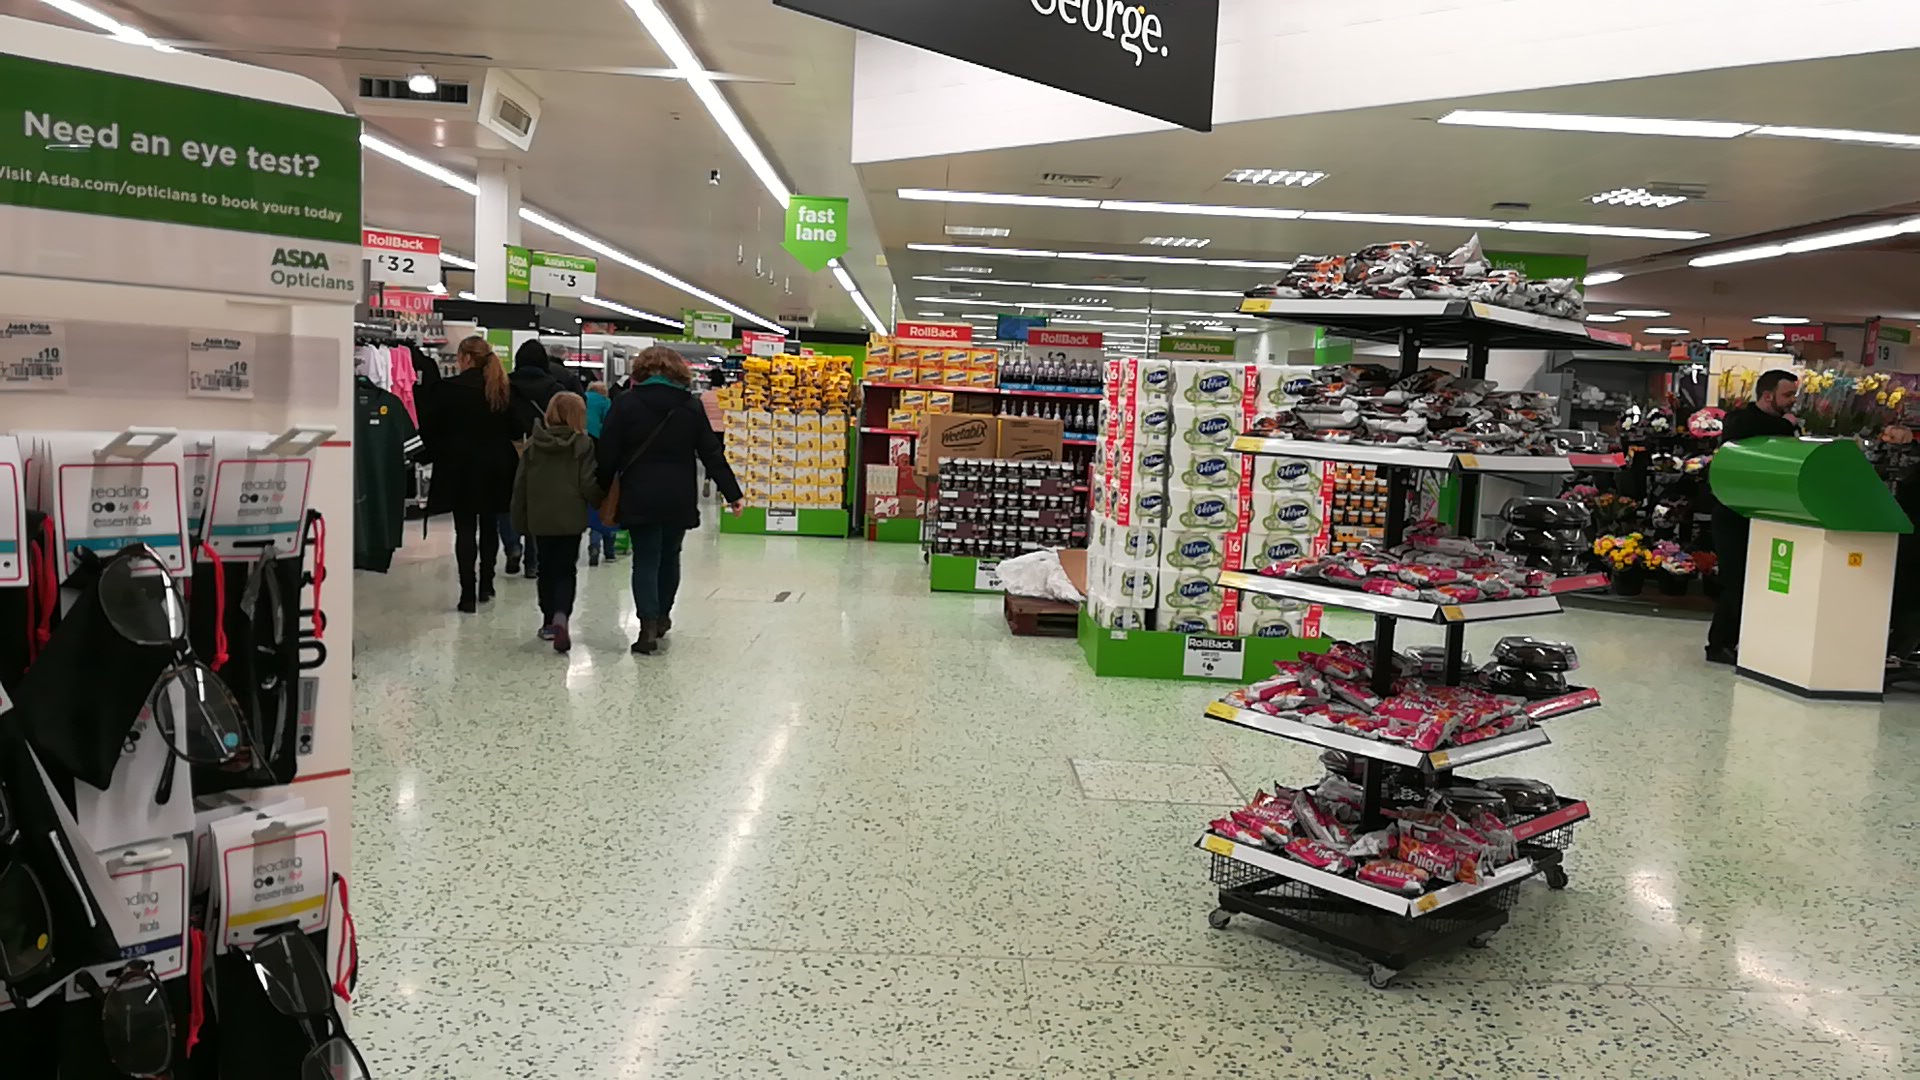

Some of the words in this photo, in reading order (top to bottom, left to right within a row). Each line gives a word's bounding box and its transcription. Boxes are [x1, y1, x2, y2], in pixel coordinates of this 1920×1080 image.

[1031, 0, 1169, 67] eorge.
[24, 110, 119, 149] Need
[131, 132, 170, 157] an
[182, 140, 237, 168] eye
[247, 146, 320, 178] test?
[38, 171, 197, 203] Asda.com/opticians
[202, 193, 217, 206] to
[221, 194, 259, 211] book
[262, 201, 301, 216] yours
[304, 206, 343, 223] today
[798, 205, 835, 224] fast
[796, 223, 838, 242] lane
[368, 233, 424, 251] RollBack
[271, 247, 330, 271] ASDA
[271, 269, 355, 291] Opticians
[909, 326, 959, 339] RollBack
[1040, 333, 1089, 346] RollBack
[1198, 342, 1221, 353] Price
[942, 424, 987, 444] Weetabix
[1325, 463, 1336, 475] 16
[91, 484, 149, 500] reading
[93, 514, 152, 529] essentials
[1228, 539, 1241, 552] 16
[1315, 543, 1327, 555] 16
[1222, 619, 1235, 631] 16
[1305, 625, 1318, 637] 16
[1188, 638, 1234, 649] RollBack
